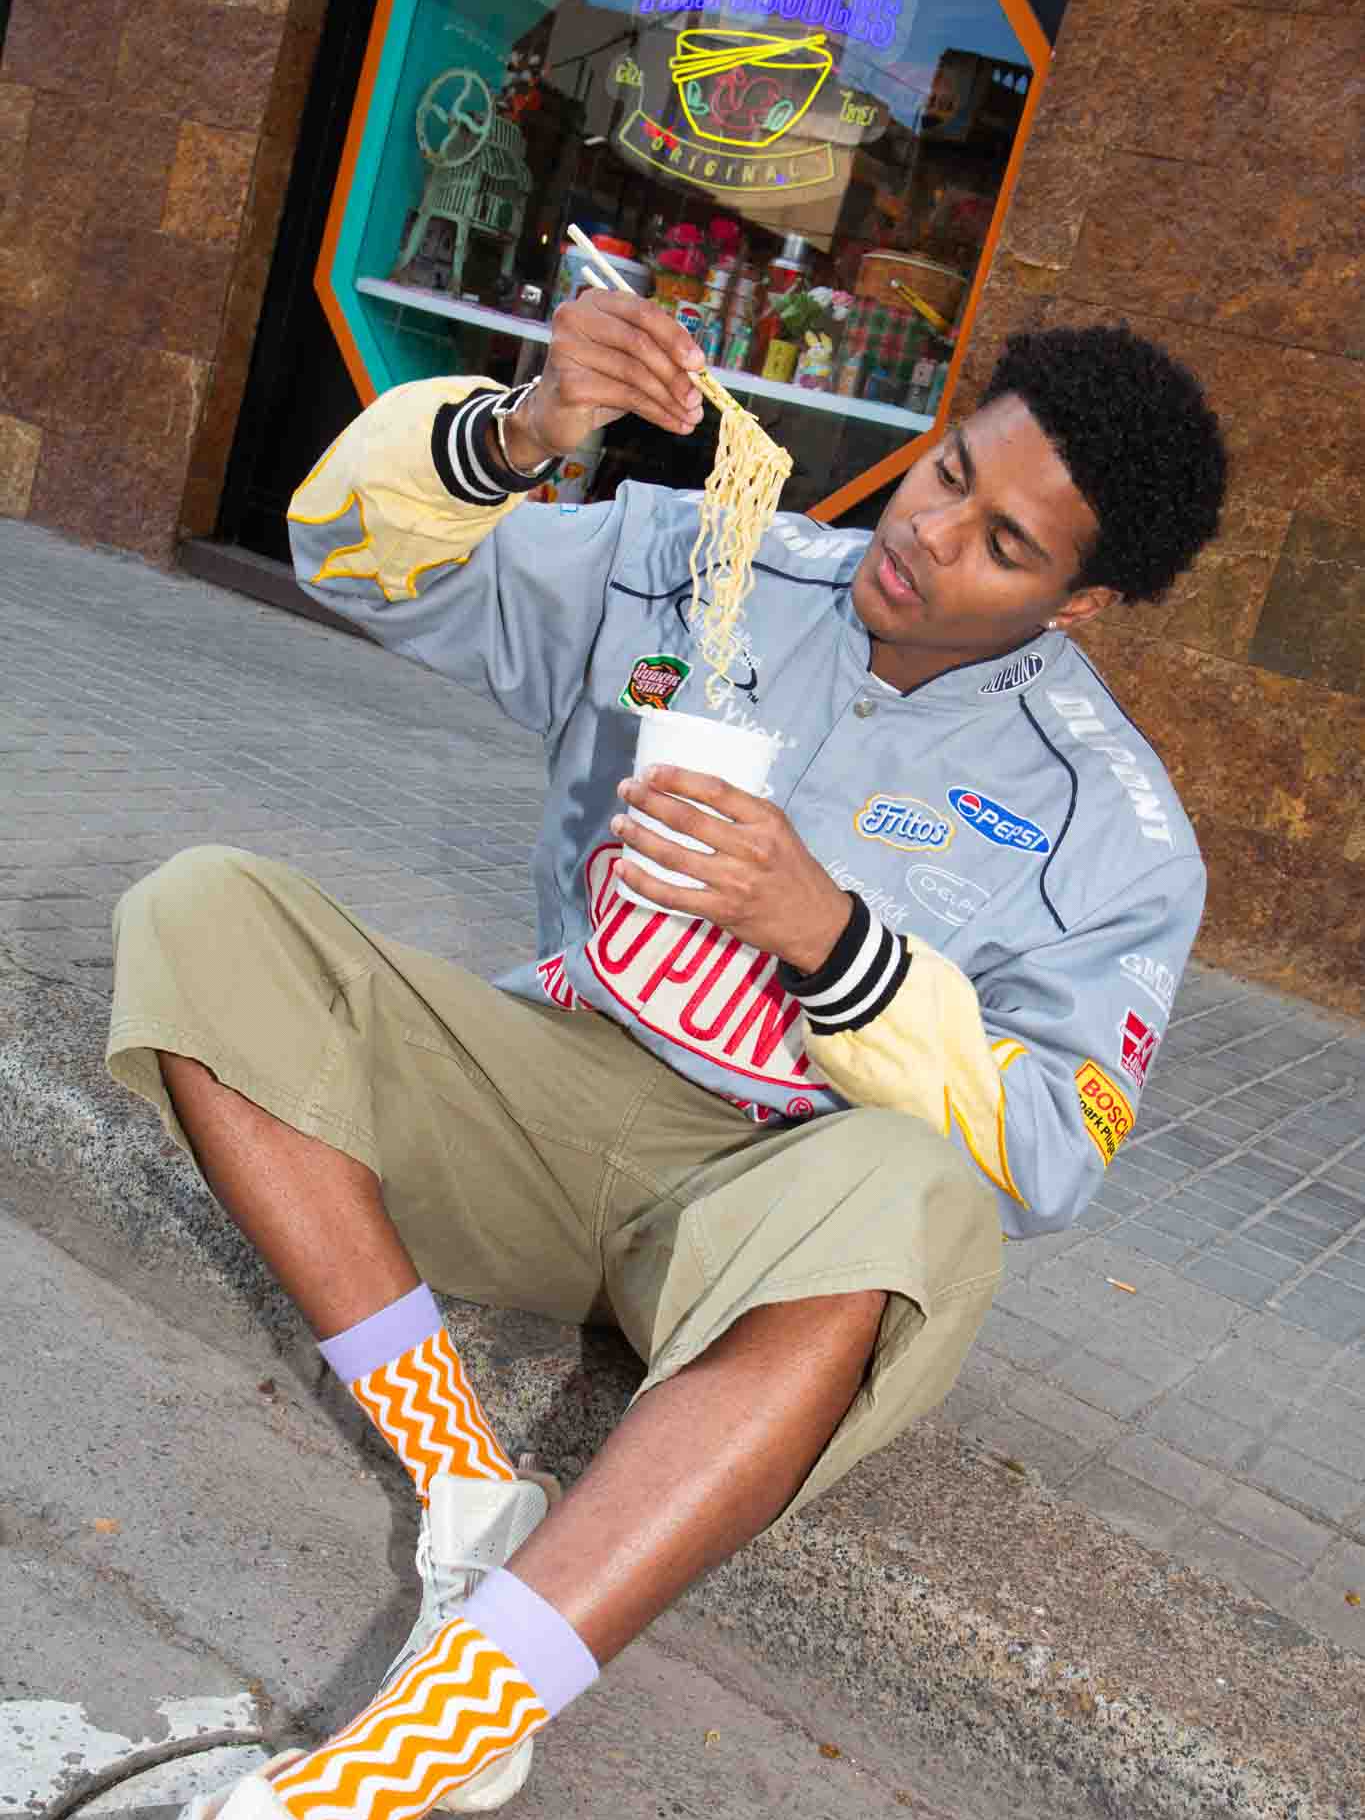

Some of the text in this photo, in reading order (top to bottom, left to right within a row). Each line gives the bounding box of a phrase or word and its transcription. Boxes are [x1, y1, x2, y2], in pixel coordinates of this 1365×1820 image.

[633, 661, 680, 687] QUAKER
[636, 679, 670, 695] STATE
[862, 802, 948, 846] Fritos
[975, 808, 1044, 850] PEPSI
